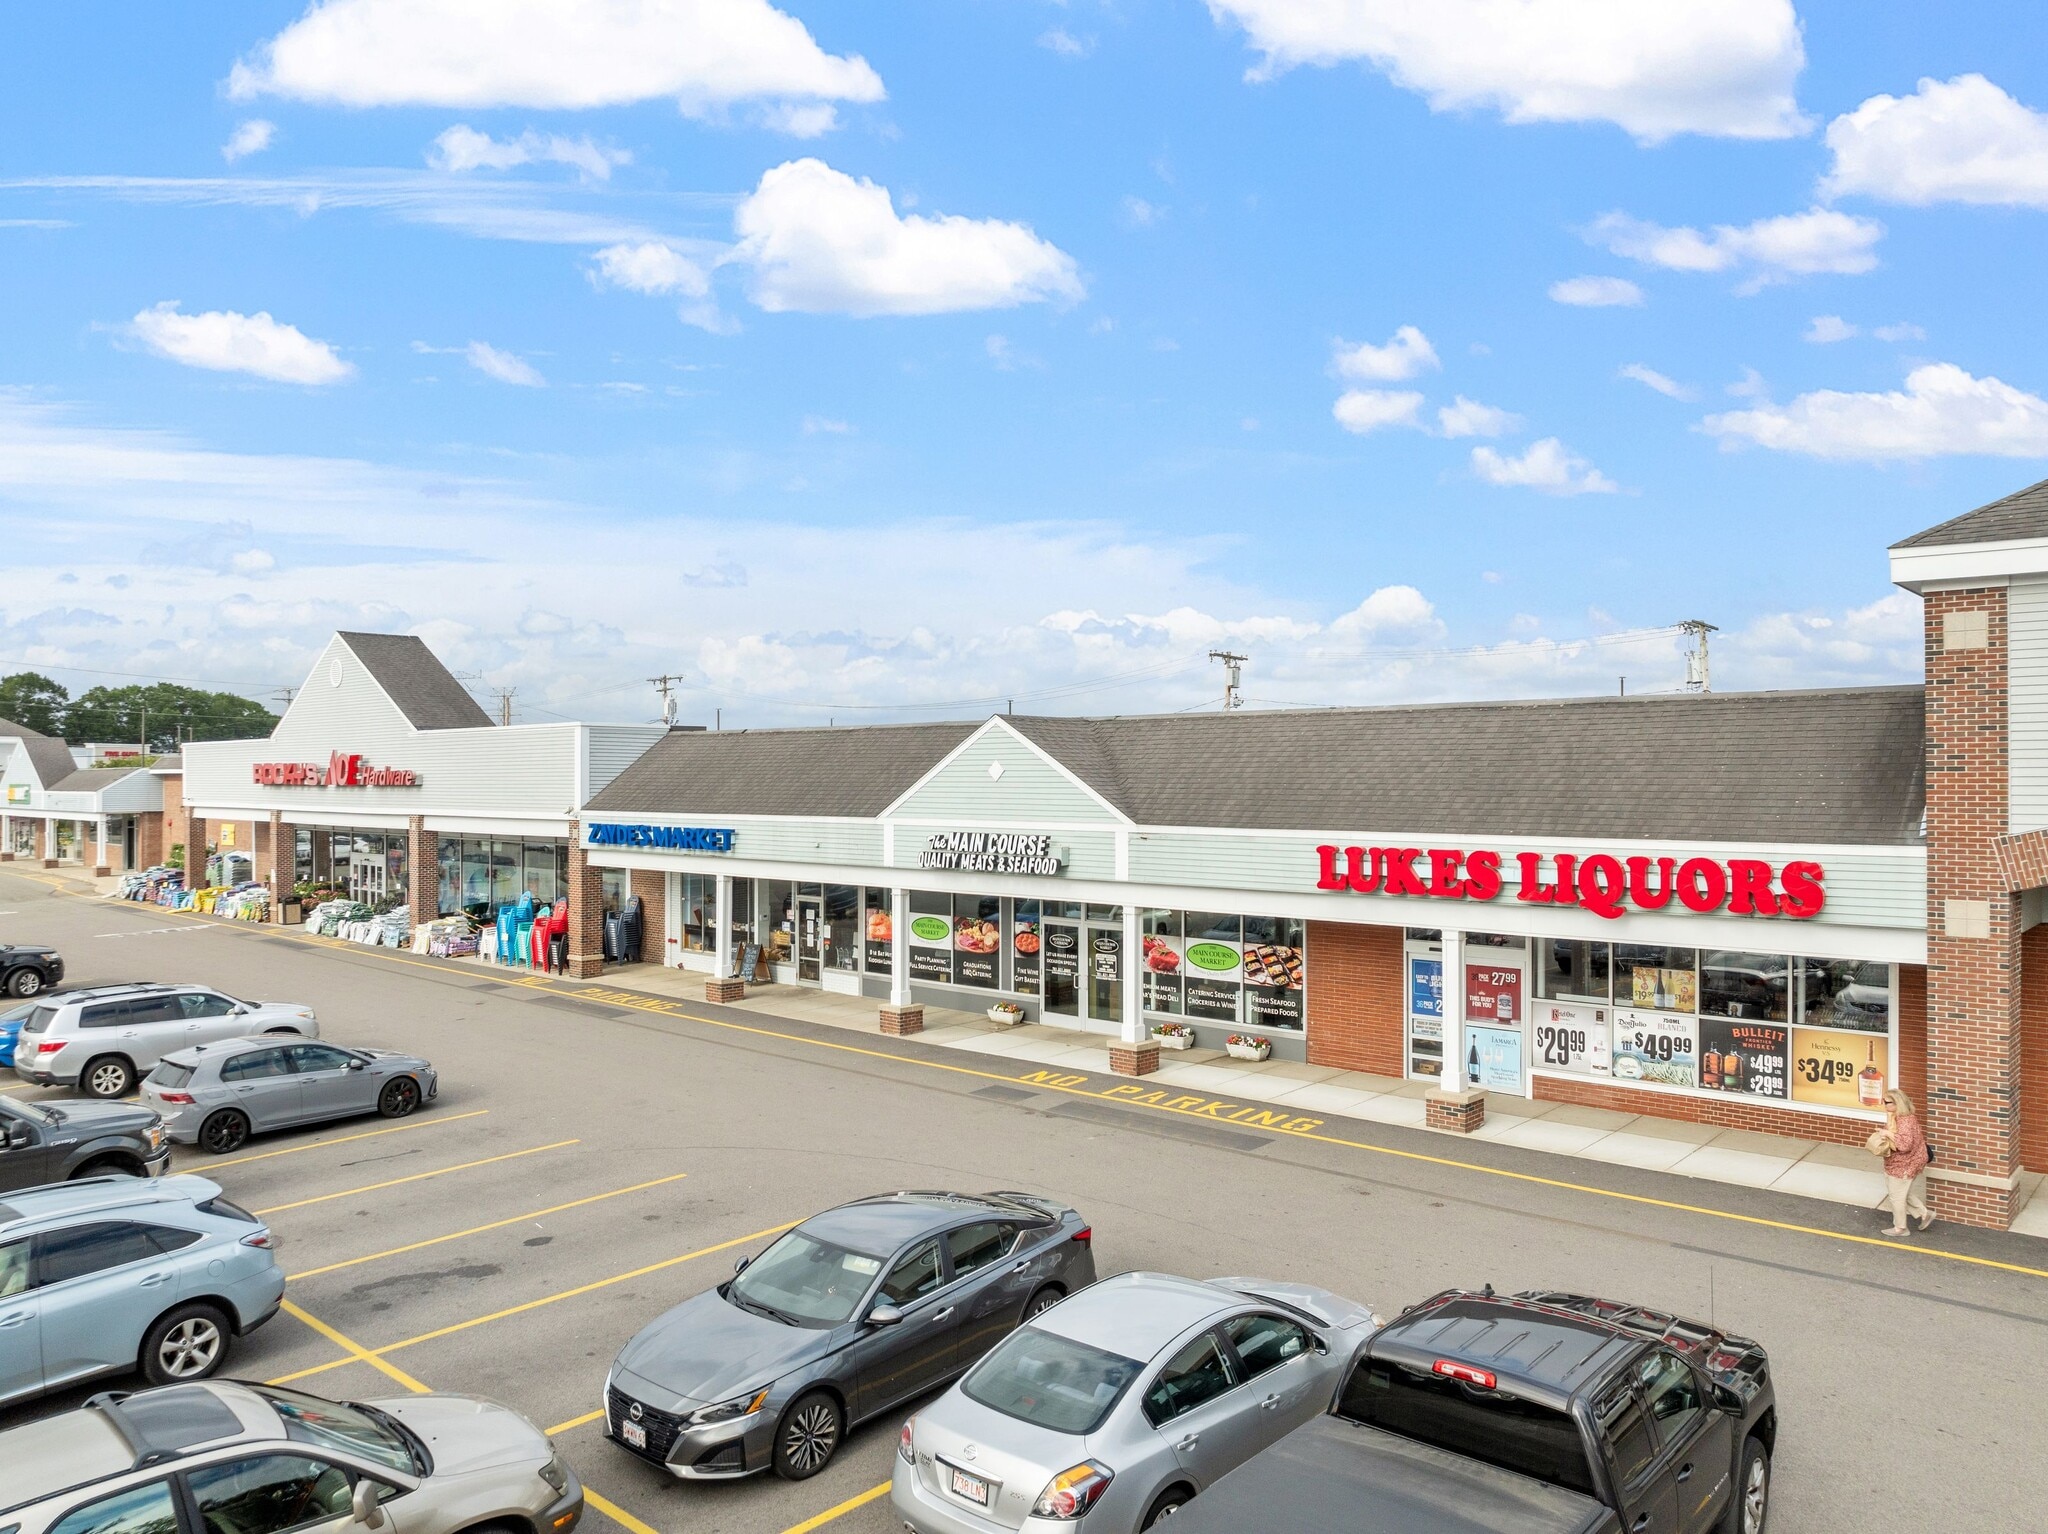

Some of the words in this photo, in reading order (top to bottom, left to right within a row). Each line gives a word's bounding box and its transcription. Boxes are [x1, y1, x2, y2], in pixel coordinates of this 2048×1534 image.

[253, 763, 320, 785] ROCKY'S
[324, 750, 362, 786] ACE
[361, 766, 416, 786] Hardware
[588, 823, 652, 846] ZAYDE'S
[653, 826, 736, 850] MARKET
[927, 835, 946, 850] The
[948, 832, 985, 852] MAIN
[988, 833, 1050, 856] COURSE
[918, 852, 958, 868] QUALITY
[960, 854, 994, 871] MEATS
[998, 858, 1005, 871] &
[1007, 857, 1058, 875] SEAFOOD
[1316, 845, 1504, 901] LUKES
[1516, 852, 1828, 919] LIQUORS
[1209, 950, 1234, 959] COURSE
[927, 956, 946, 965] PLANNING
[1200, 958, 1226, 966] MARKET
[918, 963, 933, 971] SERVICE
[963, 961, 991, 971] GRADUATIONS
[973, 970, 992, 979] CATERING
[1188, 988, 1214, 997] CATERING
[572, 987, 682, 1010] PARKING
[1188, 997, 1216, 1007] GROCERIES
[1253, 995, 1269, 1005] FRESH
[1270, 997, 1295, 1007] SEAFOOD
[1416, 1000, 1423, 1008] 36
[1251, 1006, 1278, 1015] PREPARED
[1279, 1008, 1298, 1018] FOODS
[1618, 1018, 1632, 1027] Don
[1631, 1020, 1647, 1028] Julio
[1657, 1023, 1686, 1033] BLANCO
[1732, 1027, 1785, 1042] BULLEIT
[1812, 1043, 1840, 1051] Hennessy
[1020, 1070, 1088, 1087] NO
[1102, 1084, 1325, 1131] PARKING
[954, 1475, 968, 1492] 738
